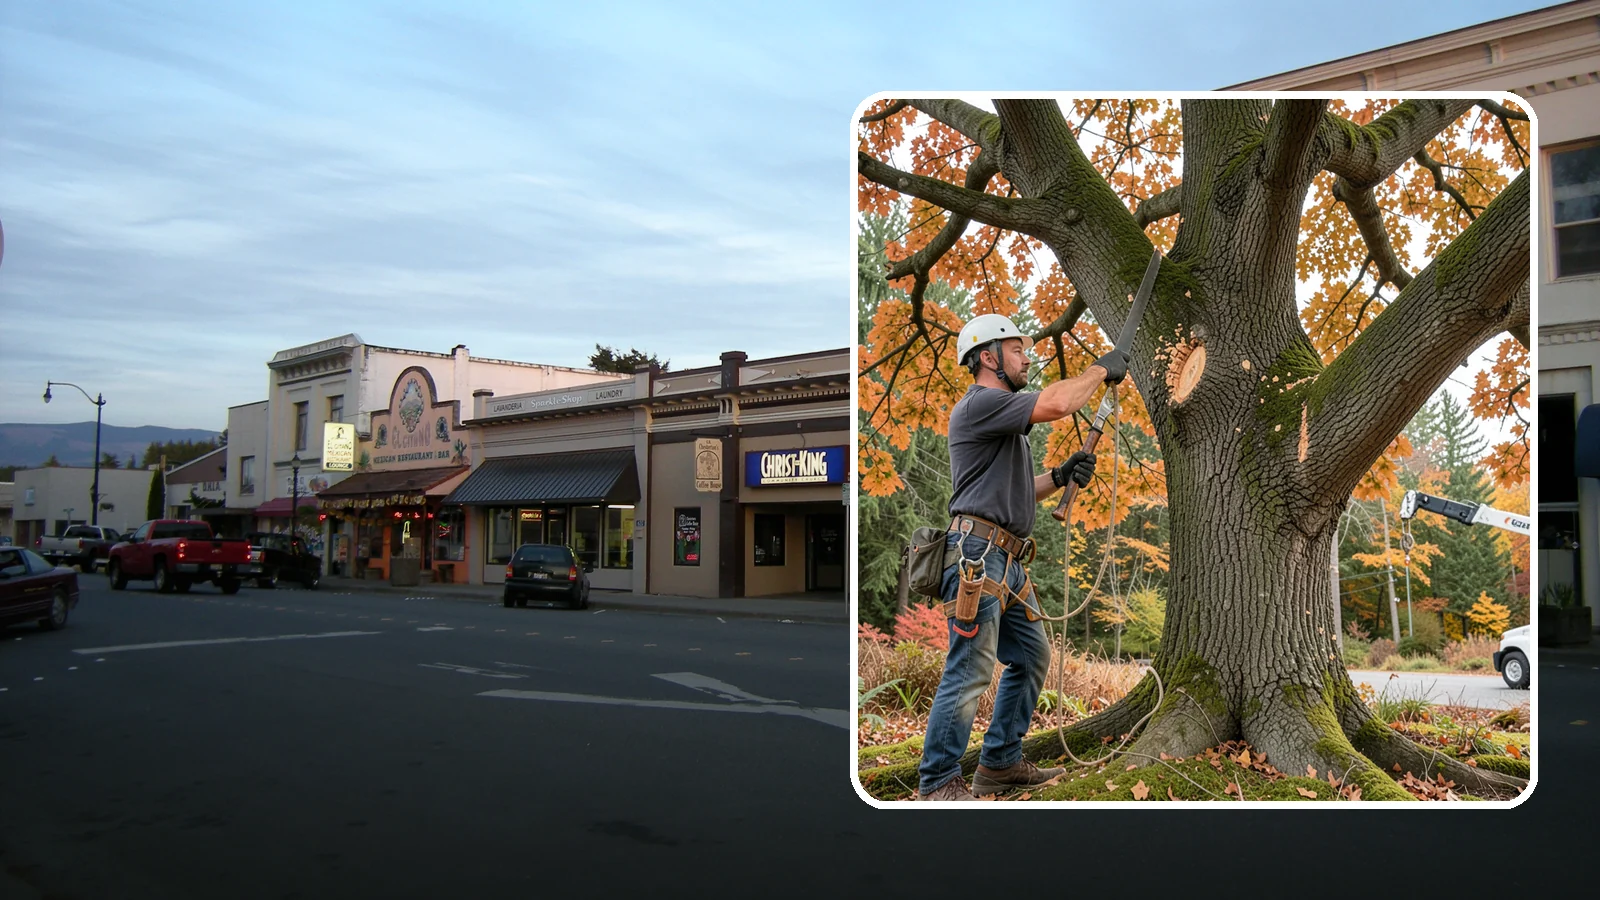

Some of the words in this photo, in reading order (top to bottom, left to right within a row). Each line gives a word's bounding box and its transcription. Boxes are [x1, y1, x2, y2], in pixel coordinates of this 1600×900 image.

[595, 389, 624, 400] LAUNDRY
[493, 402, 523, 413] LAVANDERIA
[530, 397, 561, 409] Sparkle
[562, 394, 583, 406] Shop
[373, 455, 396, 464] MEXICAN
[397, 452, 433, 462] RESTAURANT
[438, 450, 450, 459] BAR
[760, 452, 797, 478] CHRIST
[799, 450, 827, 477] KING
[696, 481, 709, 489] Coffee
[710, 481, 722, 489] House
